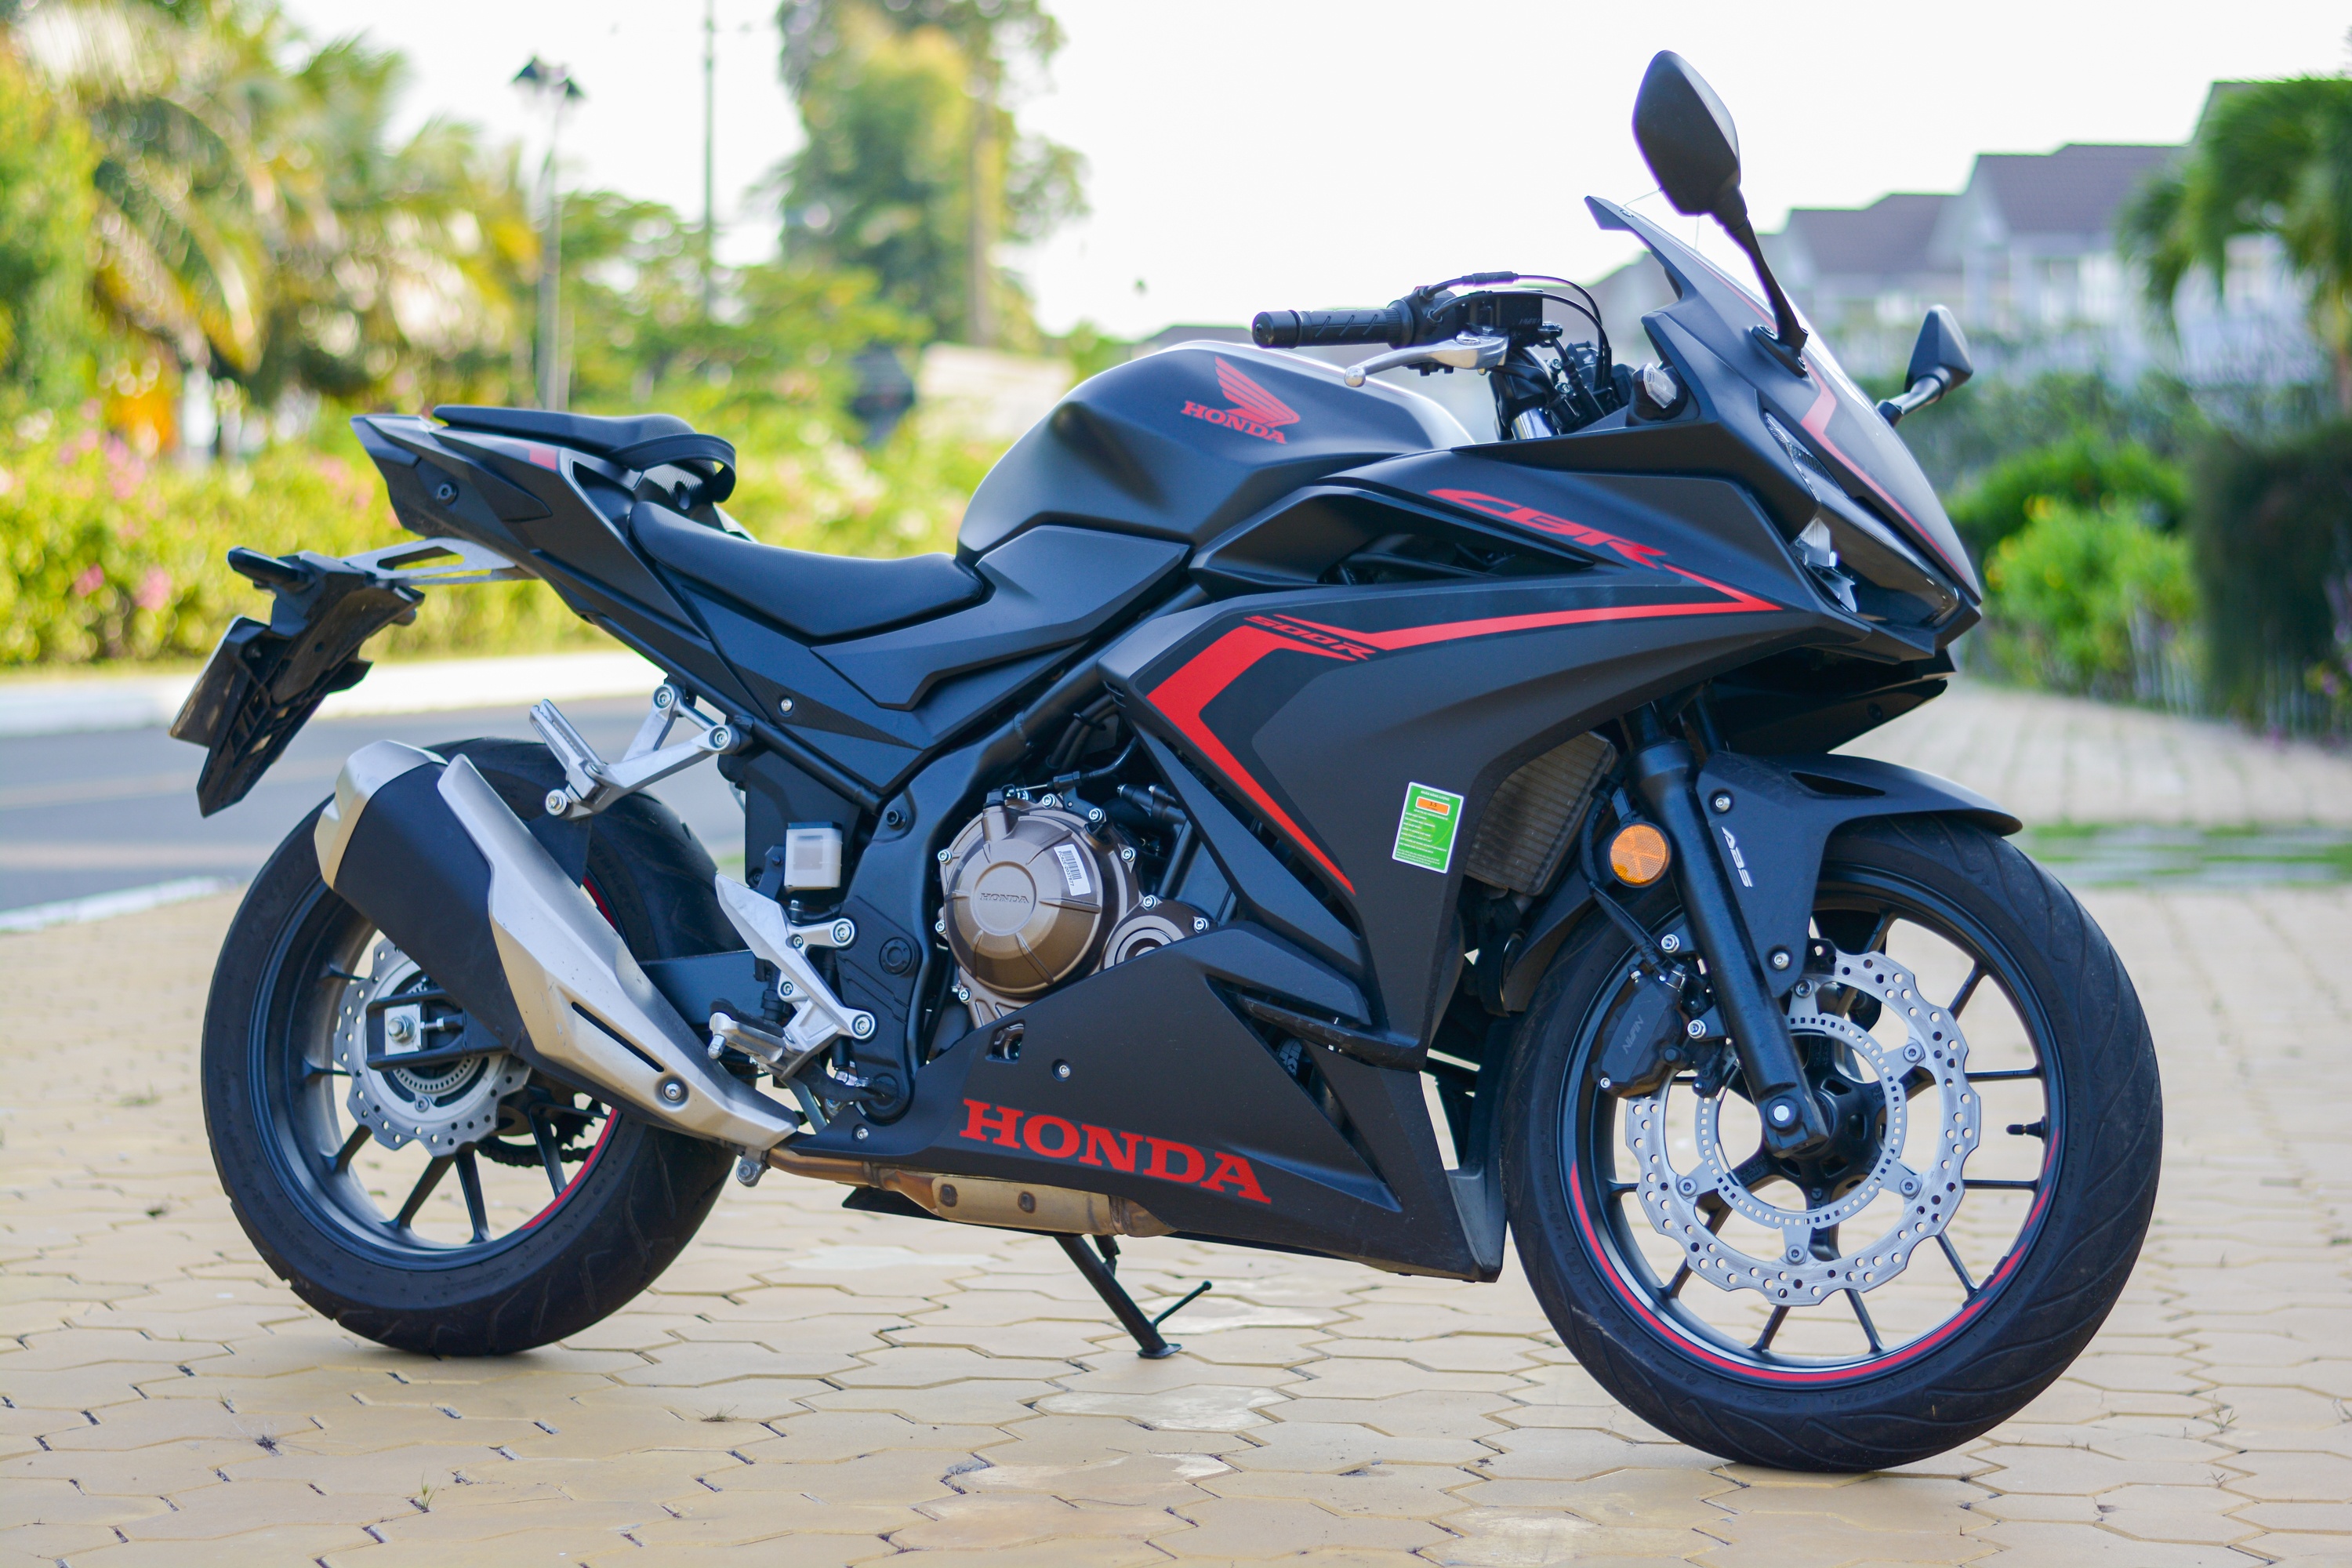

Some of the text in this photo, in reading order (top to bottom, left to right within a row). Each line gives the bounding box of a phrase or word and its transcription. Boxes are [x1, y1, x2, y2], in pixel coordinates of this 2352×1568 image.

[1181, 401, 1287, 445] HONDA
[1427, 489, 1668, 569] CBR
[1722, 826, 1753, 887] ABS
[980, 893, 1029, 903] HONDA
[960, 1098, 1272, 1204] HONDA
